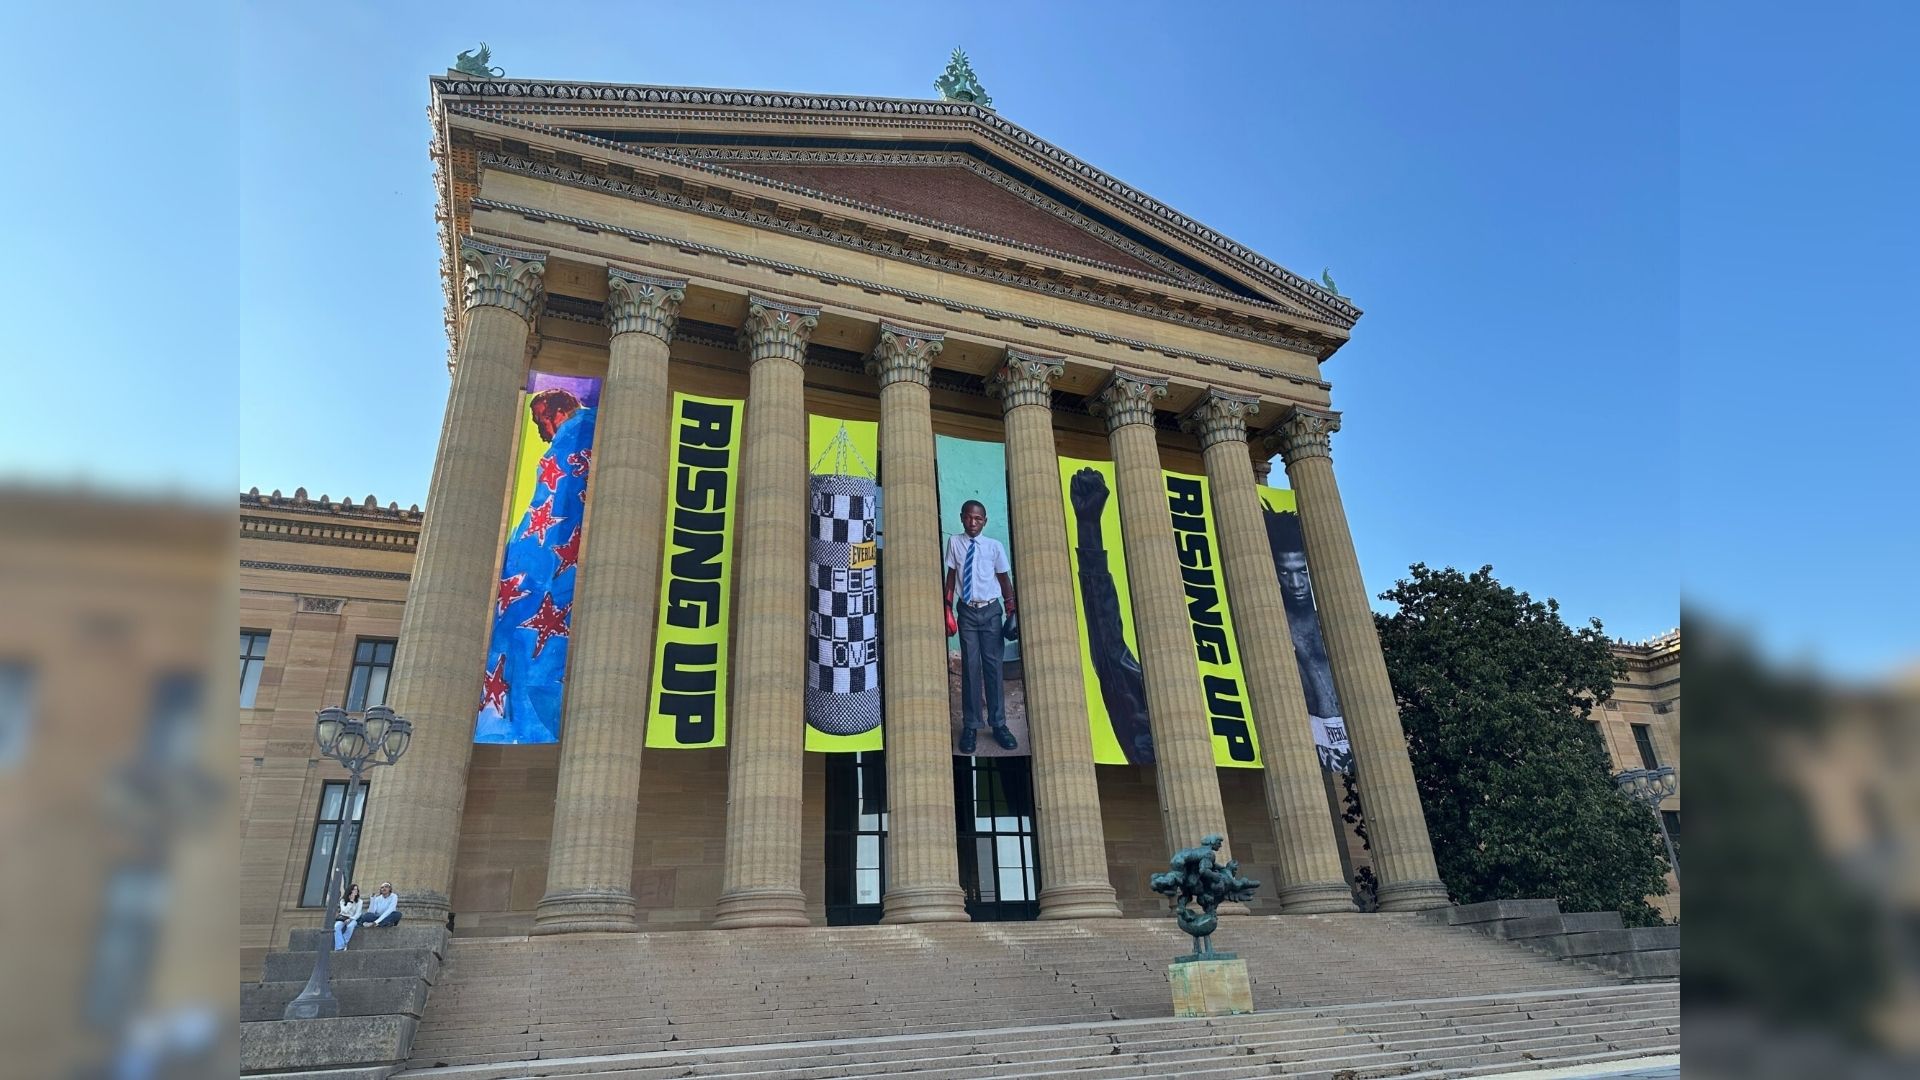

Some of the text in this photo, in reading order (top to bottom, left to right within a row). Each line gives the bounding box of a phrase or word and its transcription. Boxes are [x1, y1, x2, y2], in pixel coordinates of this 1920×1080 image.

[659, 400, 733, 745] RISING UP
[1166, 476, 1255, 762] RISING UP
